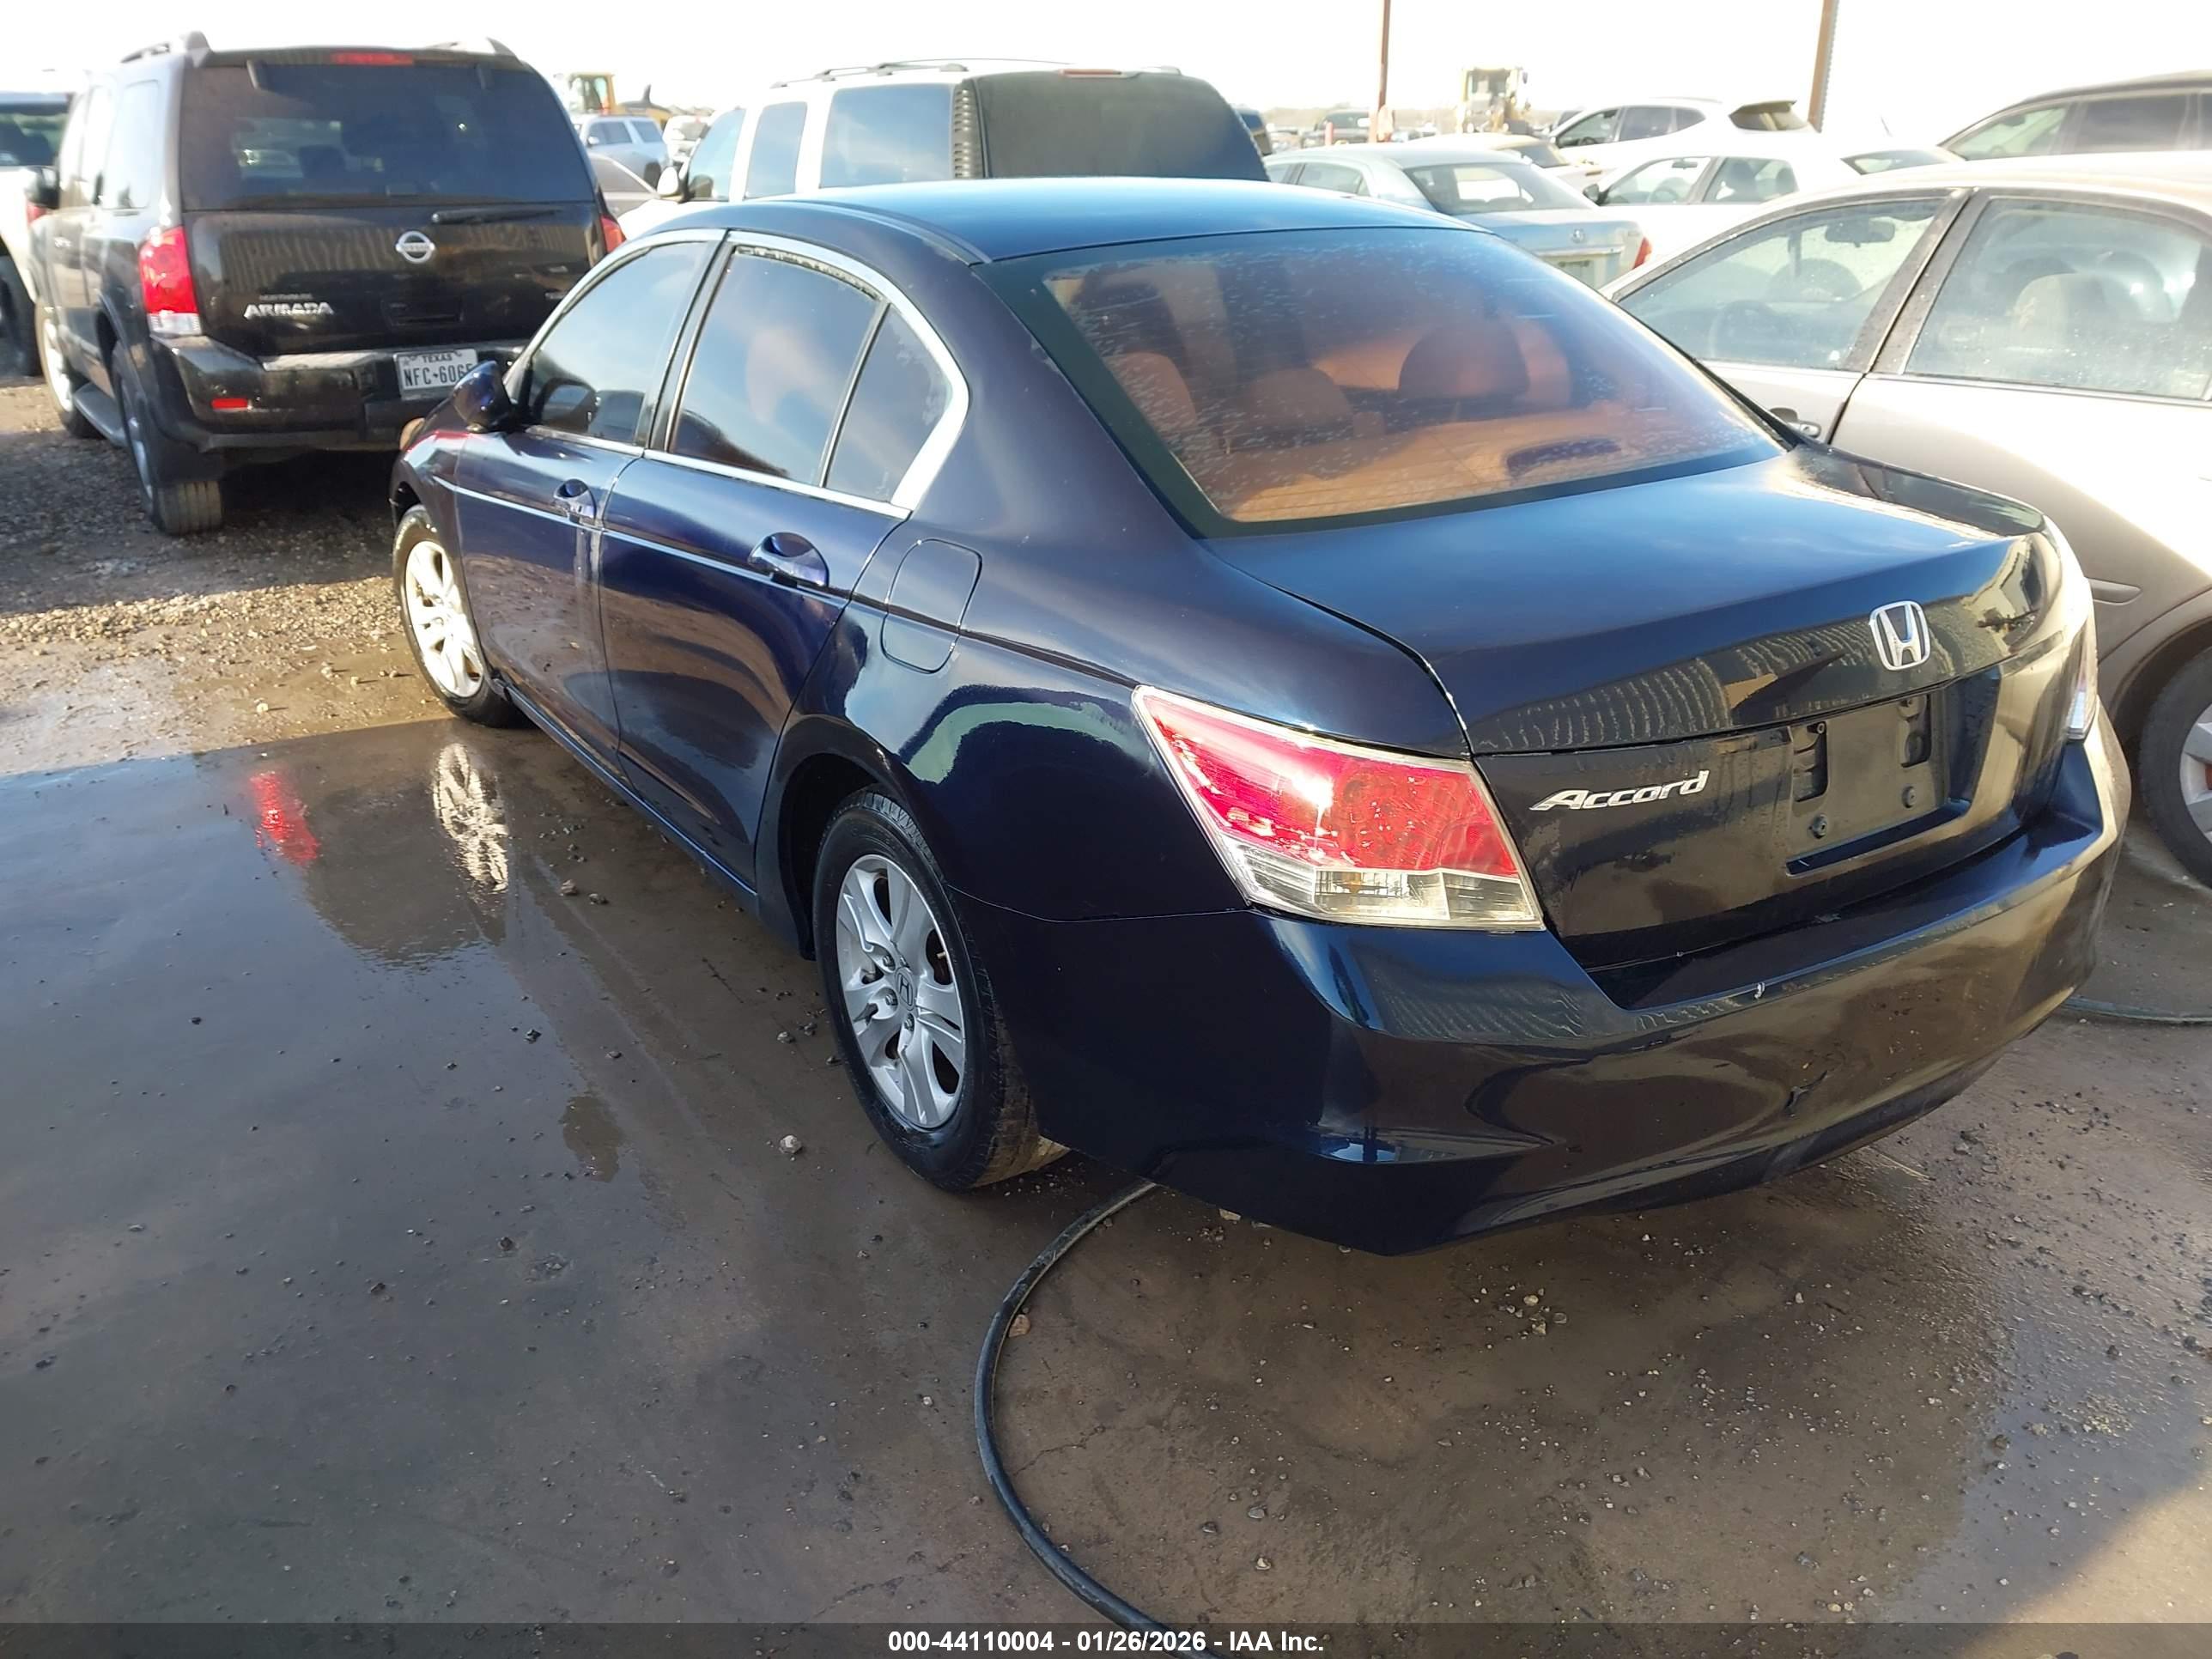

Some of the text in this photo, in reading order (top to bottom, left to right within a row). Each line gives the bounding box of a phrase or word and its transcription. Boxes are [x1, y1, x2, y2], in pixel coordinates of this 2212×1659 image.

[243, 301, 333, 319] ARMADA
[421, 353, 453, 363] TEXAS
[1529, 770, 1709, 811] Accord
